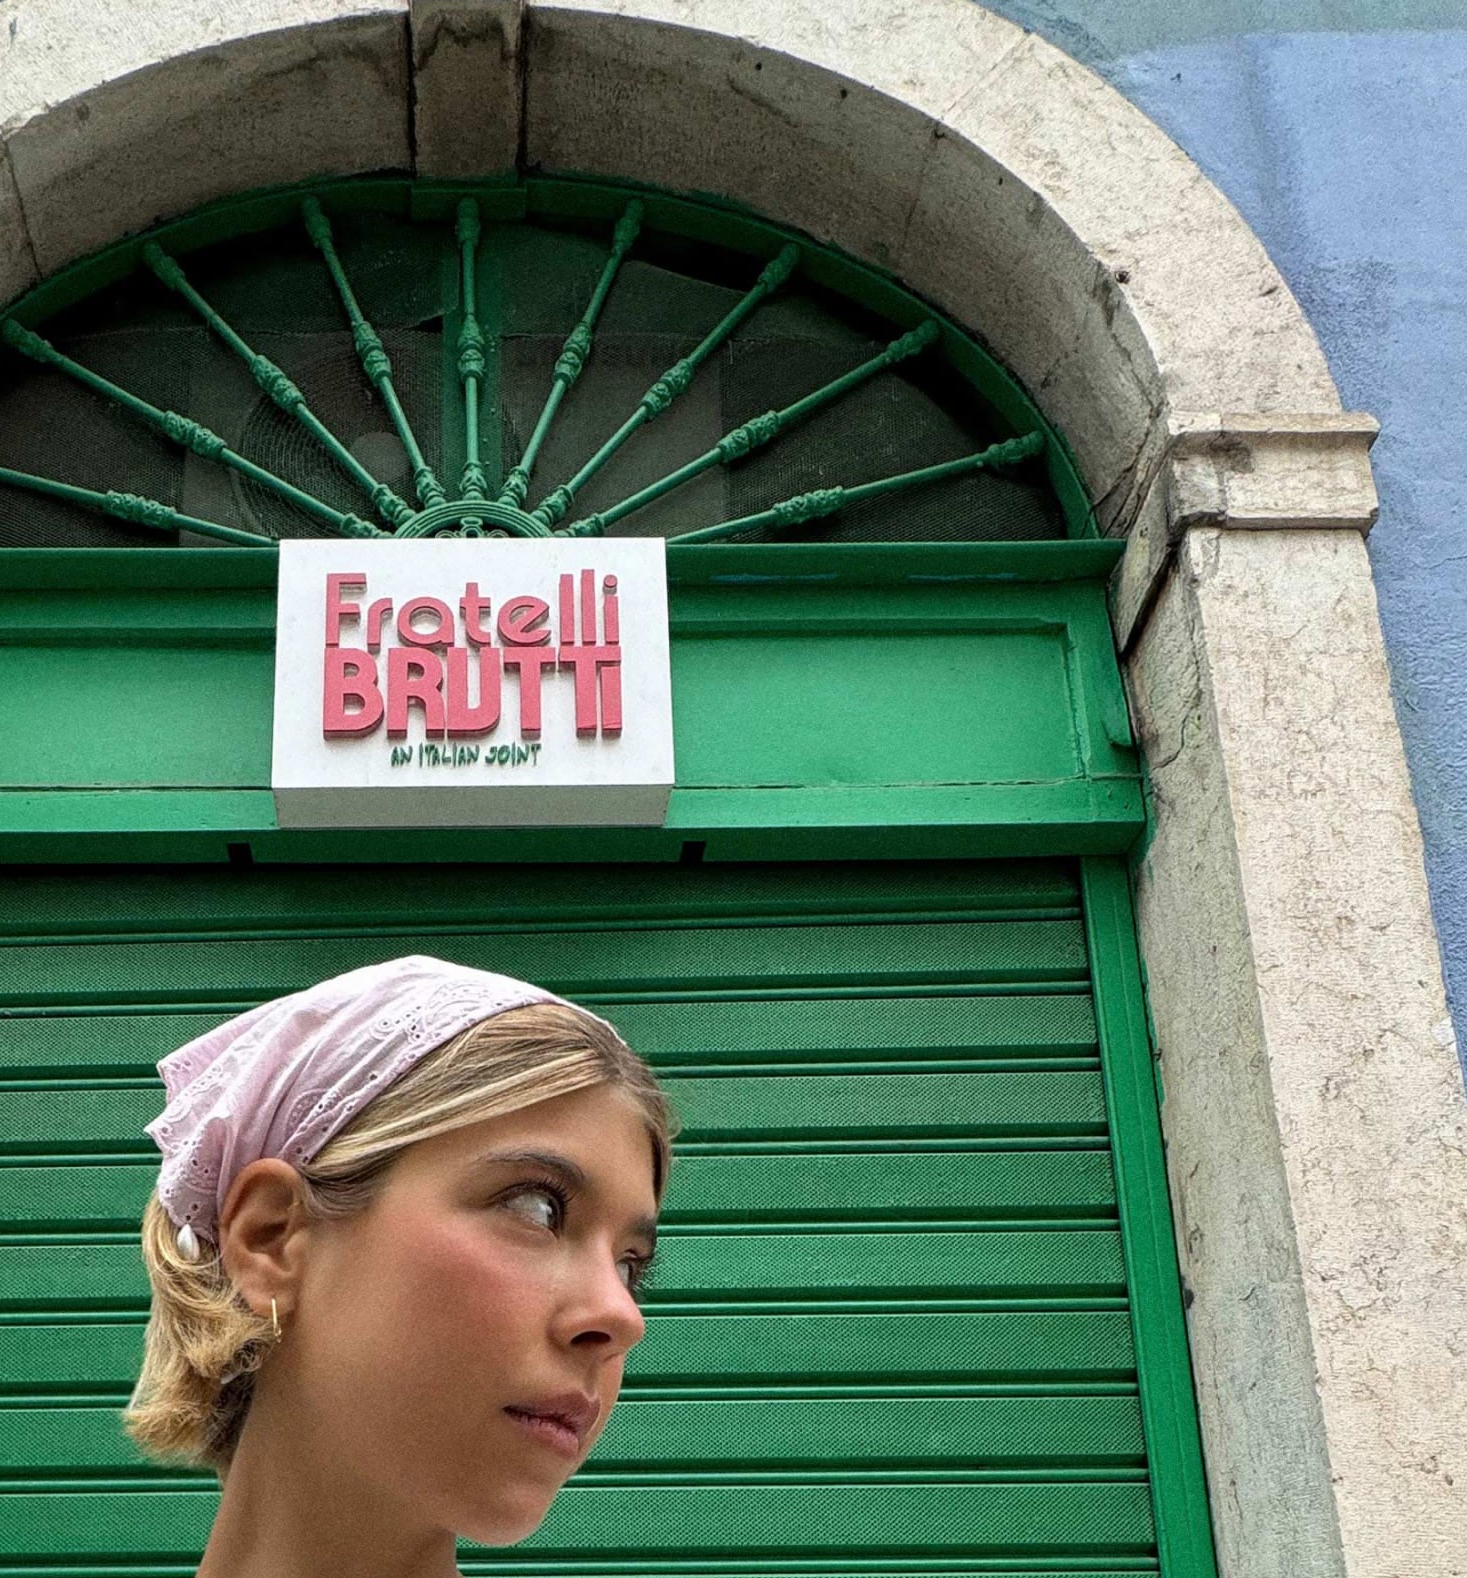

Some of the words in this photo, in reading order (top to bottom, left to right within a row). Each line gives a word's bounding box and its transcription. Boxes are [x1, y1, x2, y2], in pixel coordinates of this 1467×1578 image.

[324, 568, 620, 647] Fratelli
[323, 646, 622, 736] BRUTTI
[390, 745, 414, 767] AN
[418, 741, 480, 768] ITALIAN
[484, 741, 542, 768] JOINT
